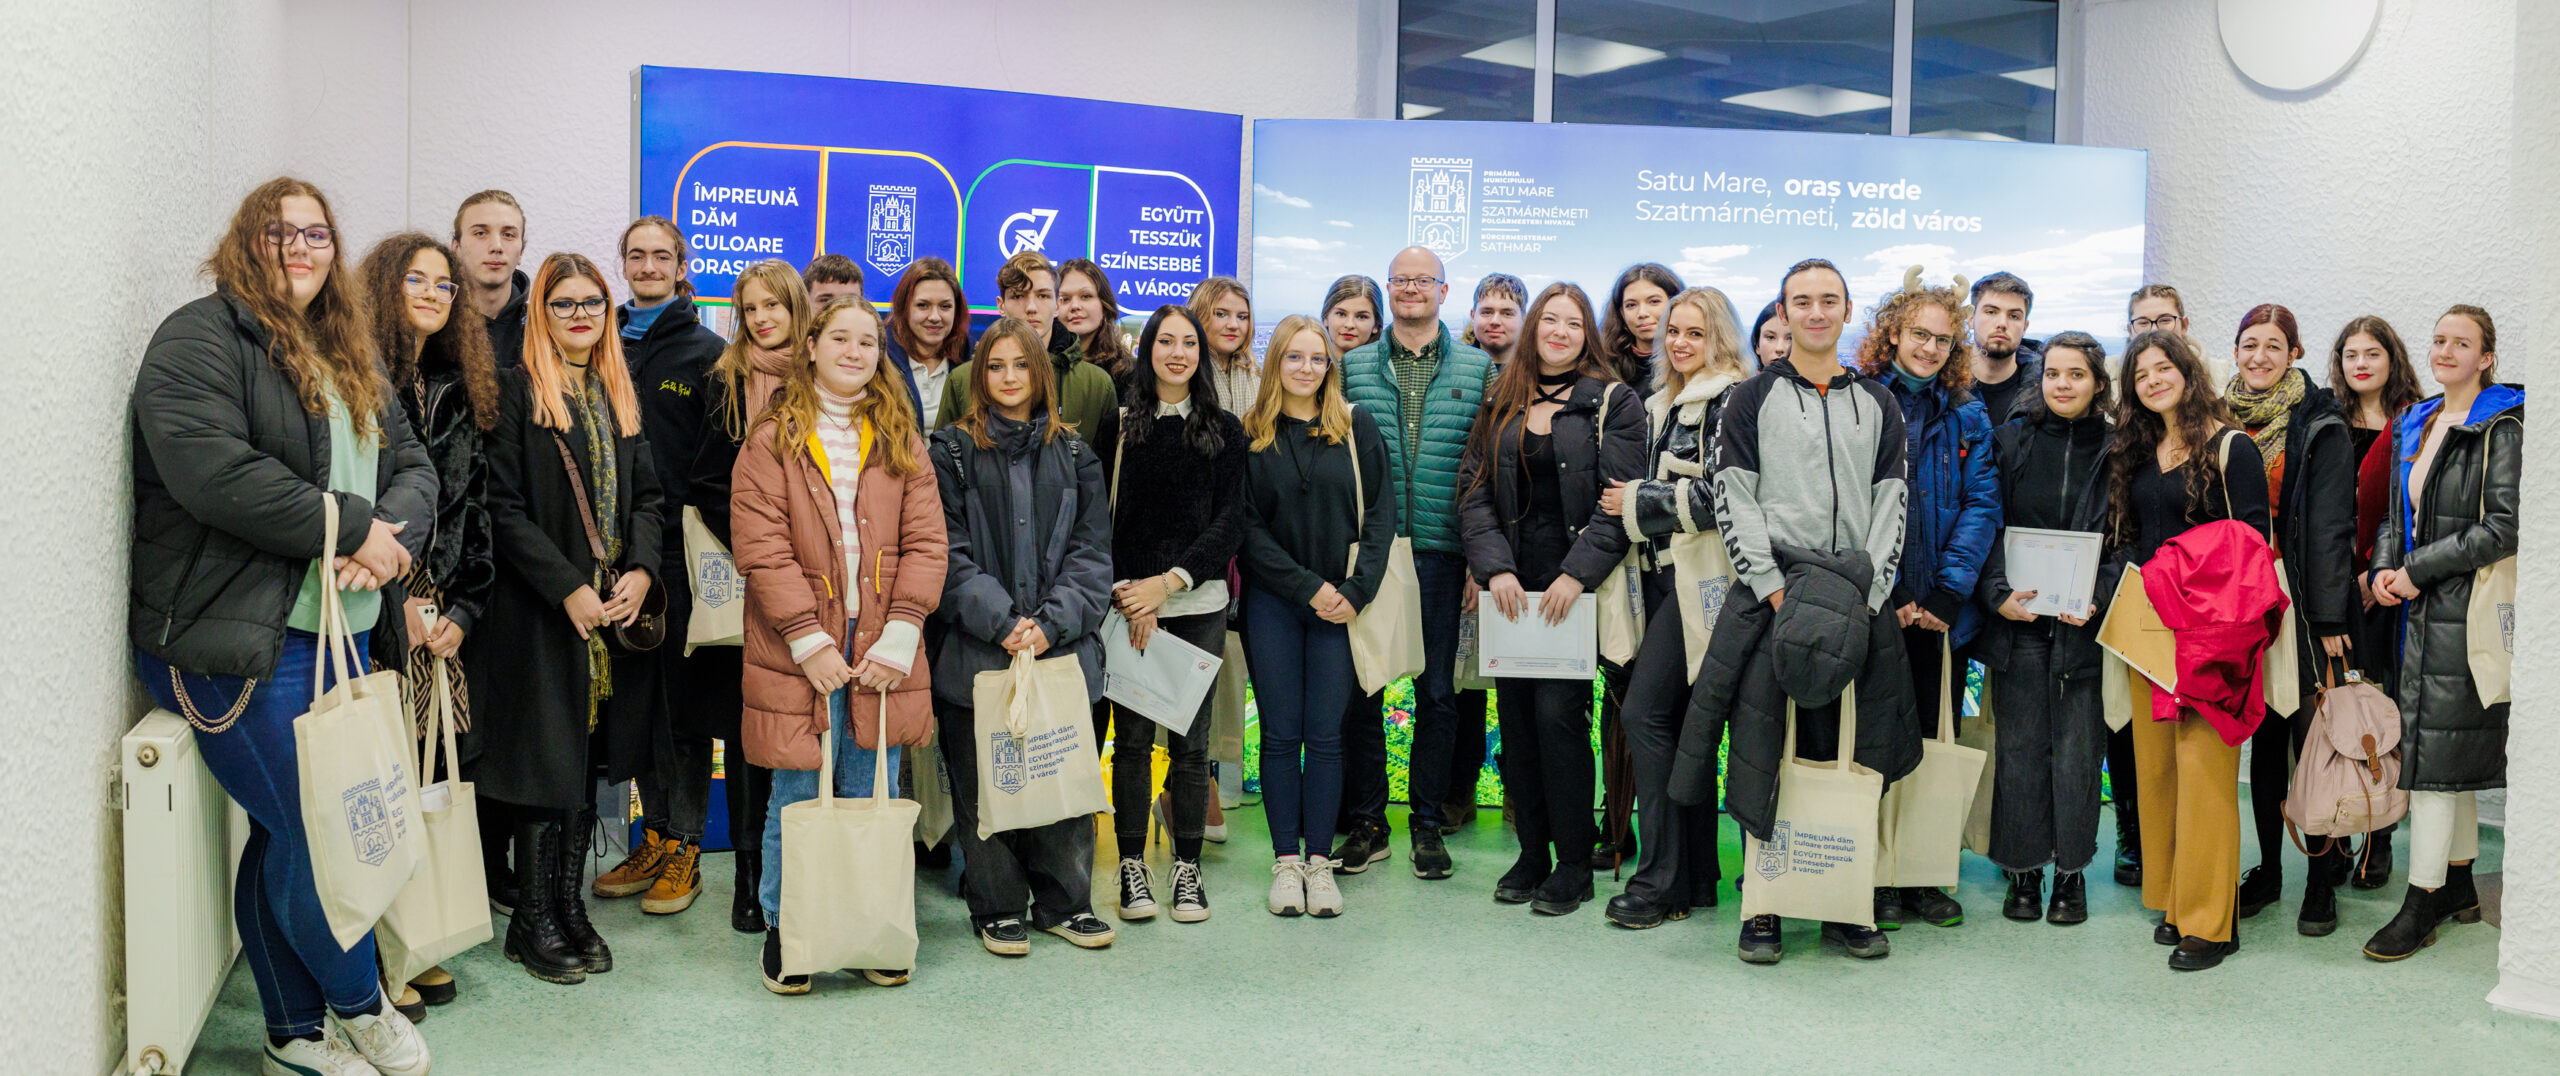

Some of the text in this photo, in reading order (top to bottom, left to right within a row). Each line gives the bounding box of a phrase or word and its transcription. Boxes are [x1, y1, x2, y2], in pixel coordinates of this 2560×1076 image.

[693, 181, 799, 207] ÎMPREUNĂ
[1482, 186, 1555, 197] SATU MARE
[1637, 170, 1922, 204] Satu Mare, oraș verde
[691, 206, 737, 228] DĂM
[1141, 206, 1204, 224] EGYÜTT
[1481, 205, 1589, 219] SZATMÁRNÉMETI
[1635, 200, 1982, 233] Szatmárnémeti, zöld város
[690, 233, 784, 254] CULOARE
[1129, 229, 1202, 248] TESSZÜK
[1480, 242, 1542, 253] SATHMAR
[1100, 251, 1202, 273] SZÍNESEBBÉ
[1118, 281, 1131, 295] A
[1714, 479, 1752, 575] STAND
[1794, 830, 1835, 842] ÎMPREUNĂ
[1794, 840, 1822, 849] culoare
[1793, 849, 1823, 859] EGYÜTT
